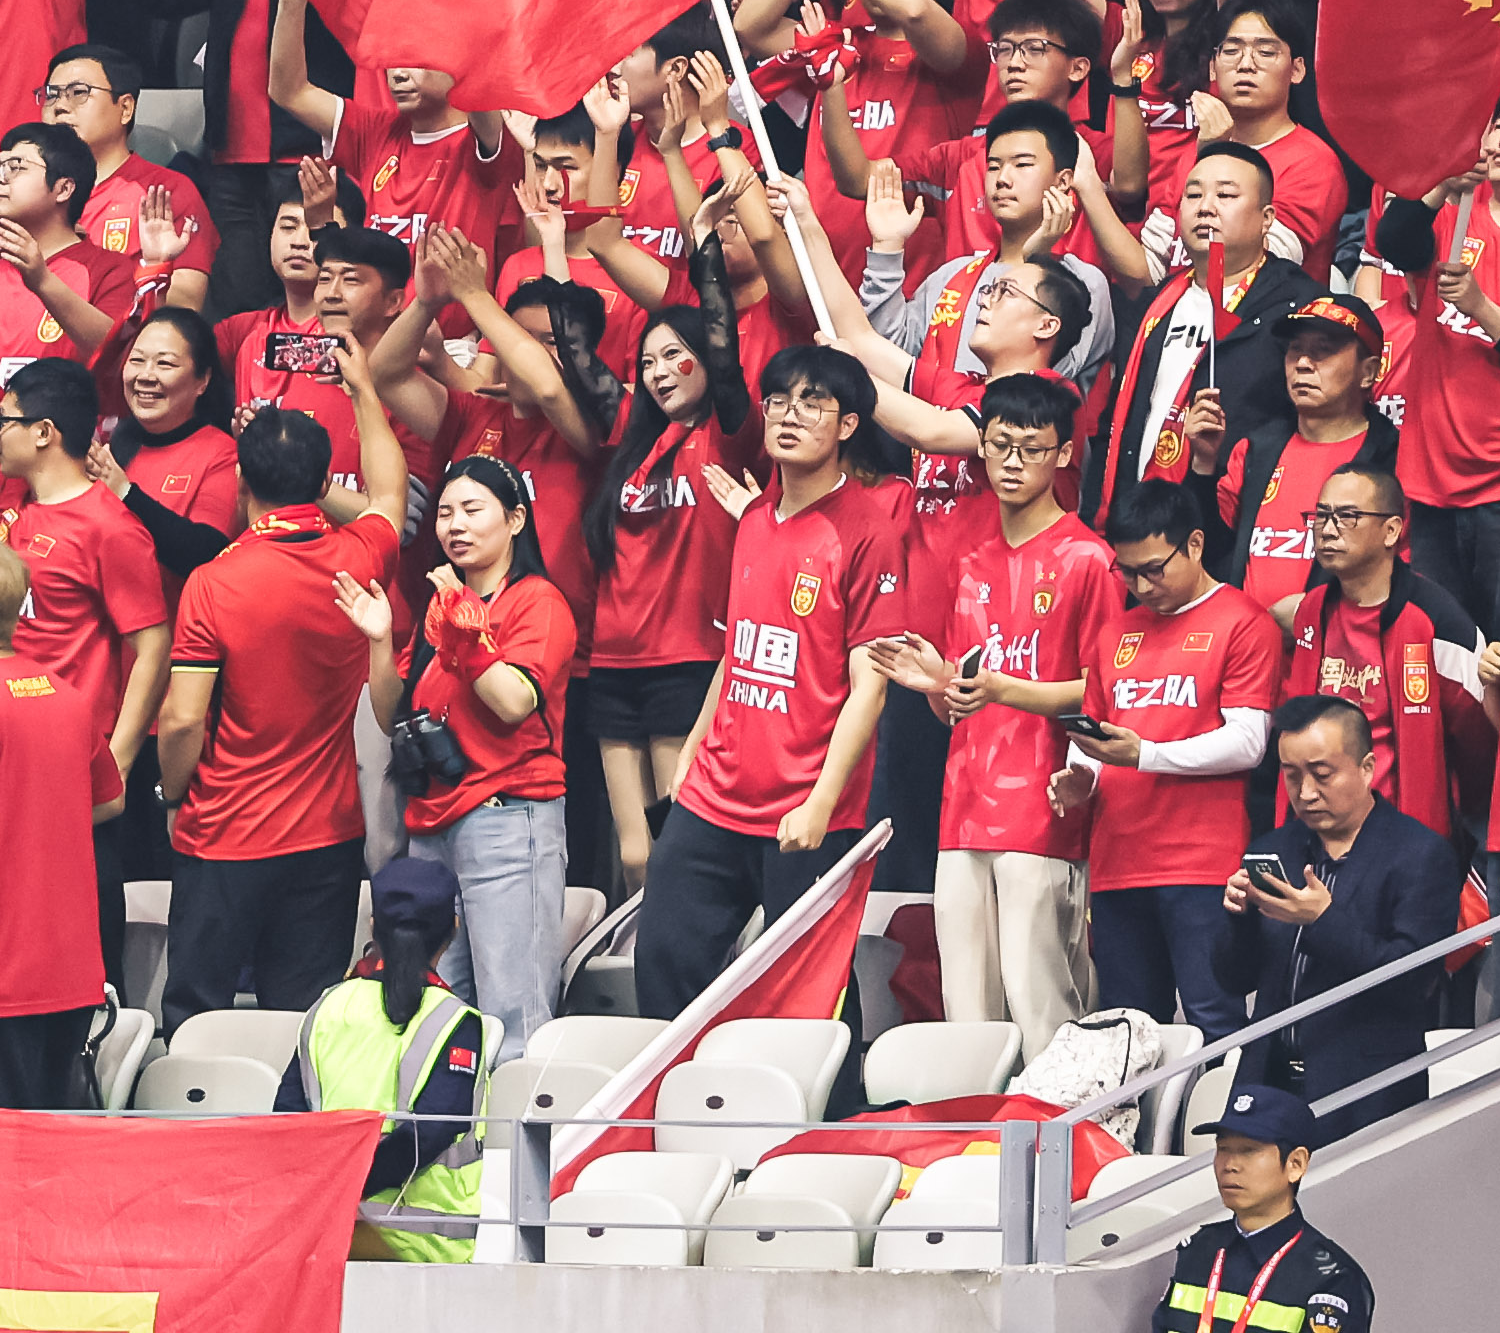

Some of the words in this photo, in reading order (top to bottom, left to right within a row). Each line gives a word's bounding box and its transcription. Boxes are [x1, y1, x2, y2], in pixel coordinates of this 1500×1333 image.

[1164, 323, 1207, 350] FIL
[732, 618, 800, 671] 中国
[1113, 675, 1197, 709] 龙之队
